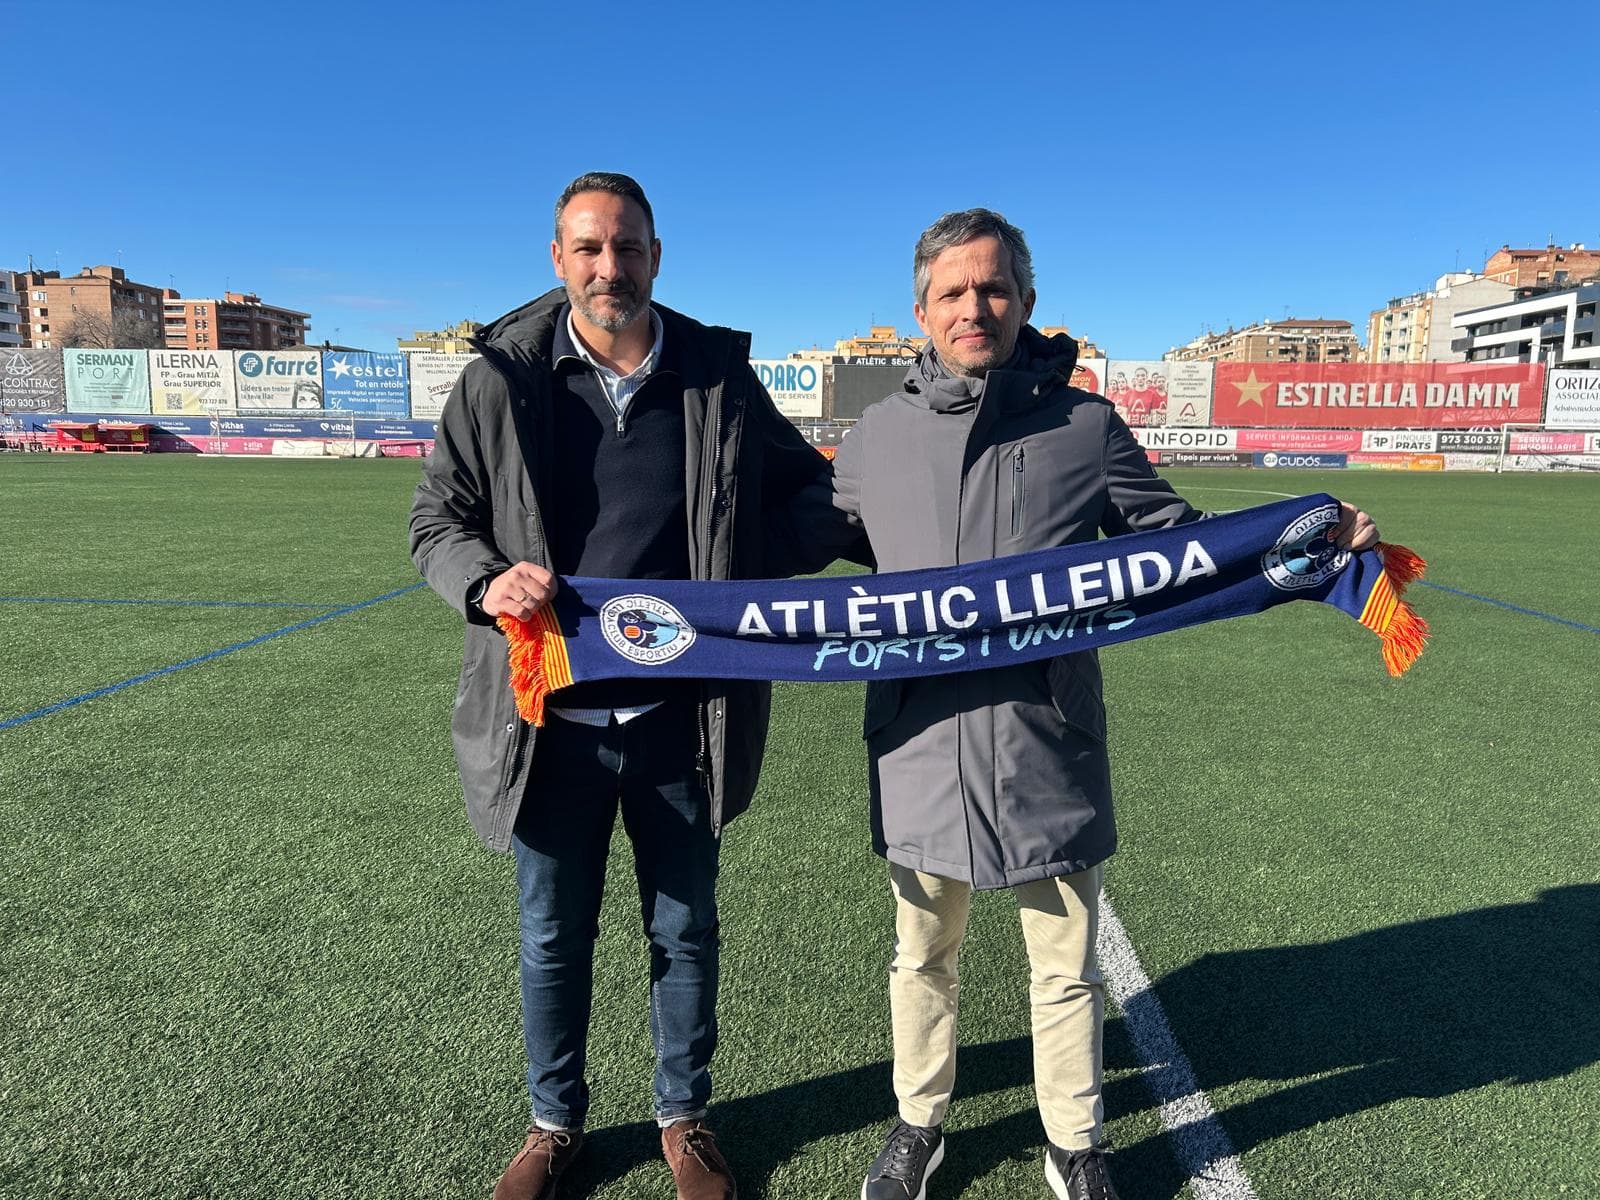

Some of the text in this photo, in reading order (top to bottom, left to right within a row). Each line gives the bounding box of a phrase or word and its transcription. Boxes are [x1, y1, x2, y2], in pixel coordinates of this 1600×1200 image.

[77, 353, 134, 366] SERMAN
[156, 353, 218, 368] iLERNA
[266, 356, 318, 375] farré
[77, 367, 134, 379] PORT
[352, 362, 403, 377] estel
[1, 377, 59, 388] CONTRAC
[1276, 382, 1520, 408] ESTRELLA DAMM
[18, 399, 33, 407] 930
[1147, 432, 1227, 446] INFOPID
[1246, 433, 1276, 441] SERVEIS
[1441, 435, 1461, 444] 973
[1464, 435, 1483, 444] 300
[1395, 442, 1431, 450] PRATS
[1176, 453, 1198, 462] Espais
[1279, 456, 1320, 466] CUDÓS
[736, 540, 1218, 638] ATLÈTIC LLEIDA
[608, 624, 678, 659] CLUB ESPORTIU
[813, 633, 965, 671] FORTS
[1009, 604, 1136, 651] UNITS
